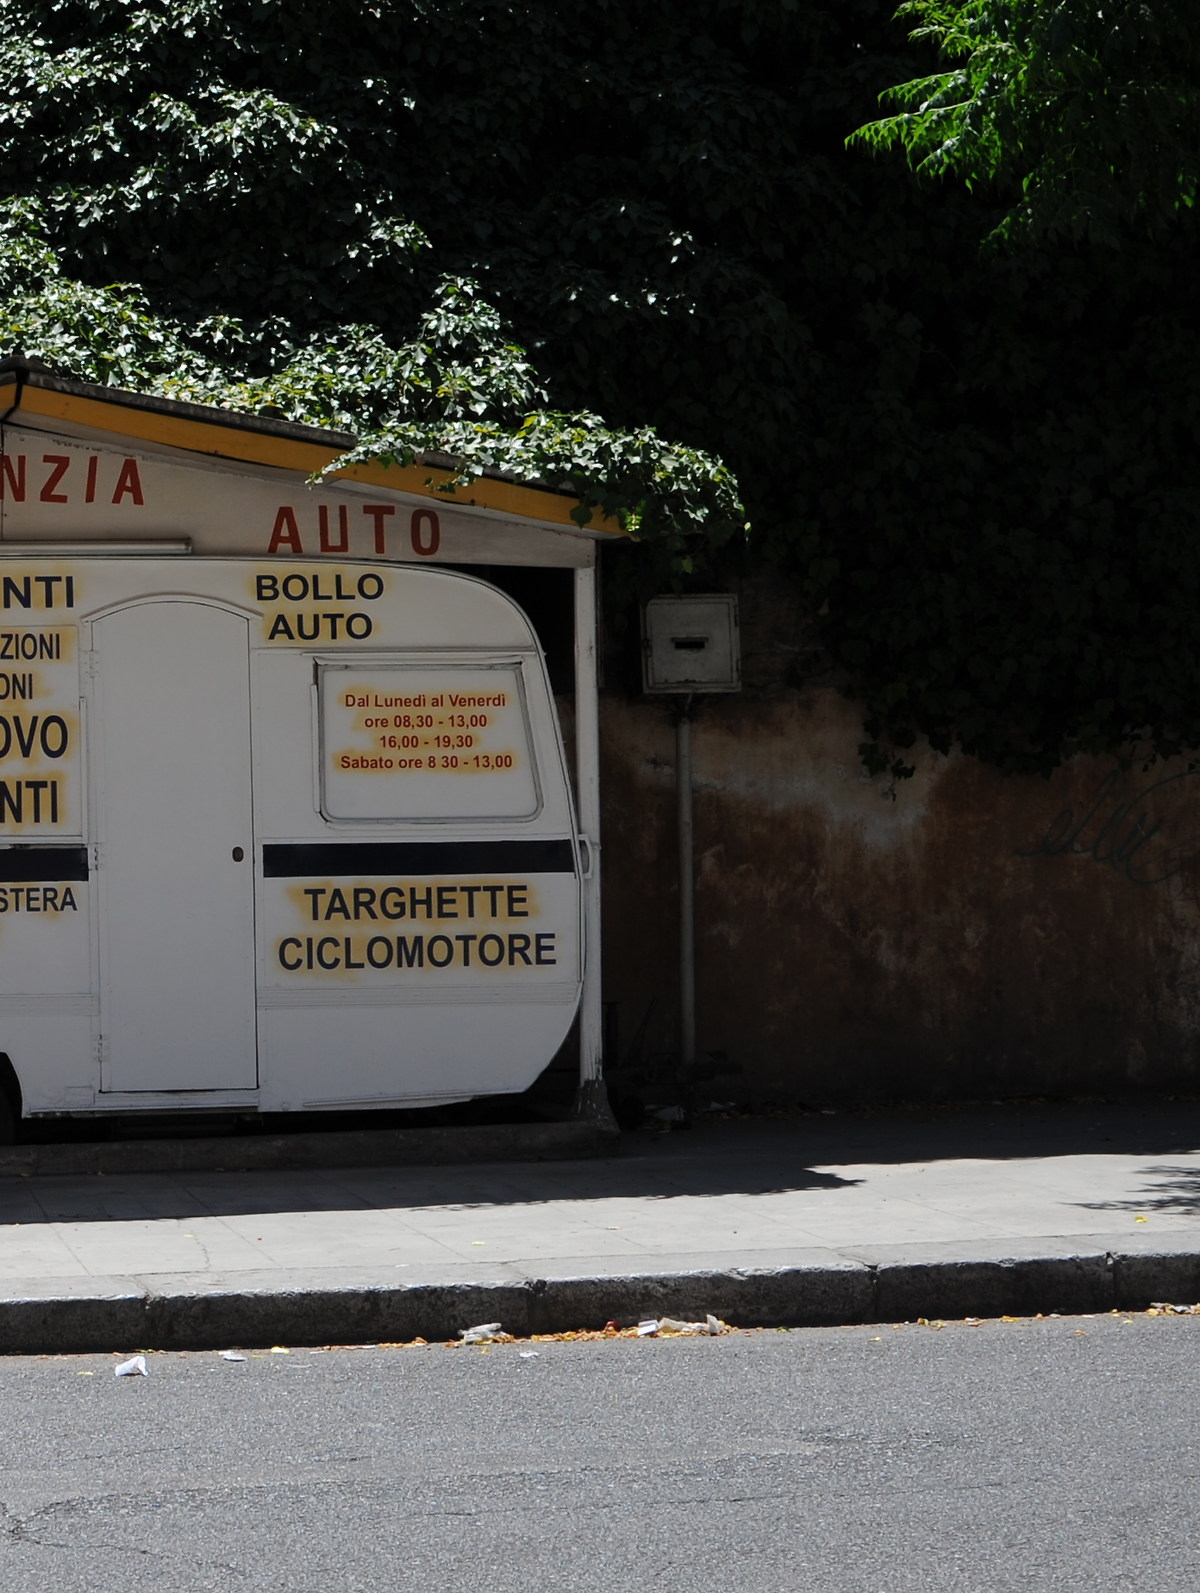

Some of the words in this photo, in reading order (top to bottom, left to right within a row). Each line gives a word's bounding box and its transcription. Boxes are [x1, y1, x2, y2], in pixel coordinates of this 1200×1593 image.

[269, 505, 439, 555] AUTO
[256, 574, 383, 601] BOLLO
[269, 613, 372, 640] AUTO
[346, 695, 369, 707] Dal
[375, 695, 426, 707] Lunedì
[432, 695, 443, 707] al
[449, 694, 505, 707] Venerdì
[365, 718, 388, 727] ore
[394, 715, 433, 729] 08,30
[449, 715, 487, 729] 13,00
[380, 736, 418, 749] 16,00
[434, 735, 472, 749] 19,30
[341, 756, 393, 768] Sabato
[399, 759, 422, 768] ore
[473, 755, 512, 769] 13,00
[304, 885, 528, 920] TARGHETTE
[279, 933, 556, 970] CICLOMOTORE
